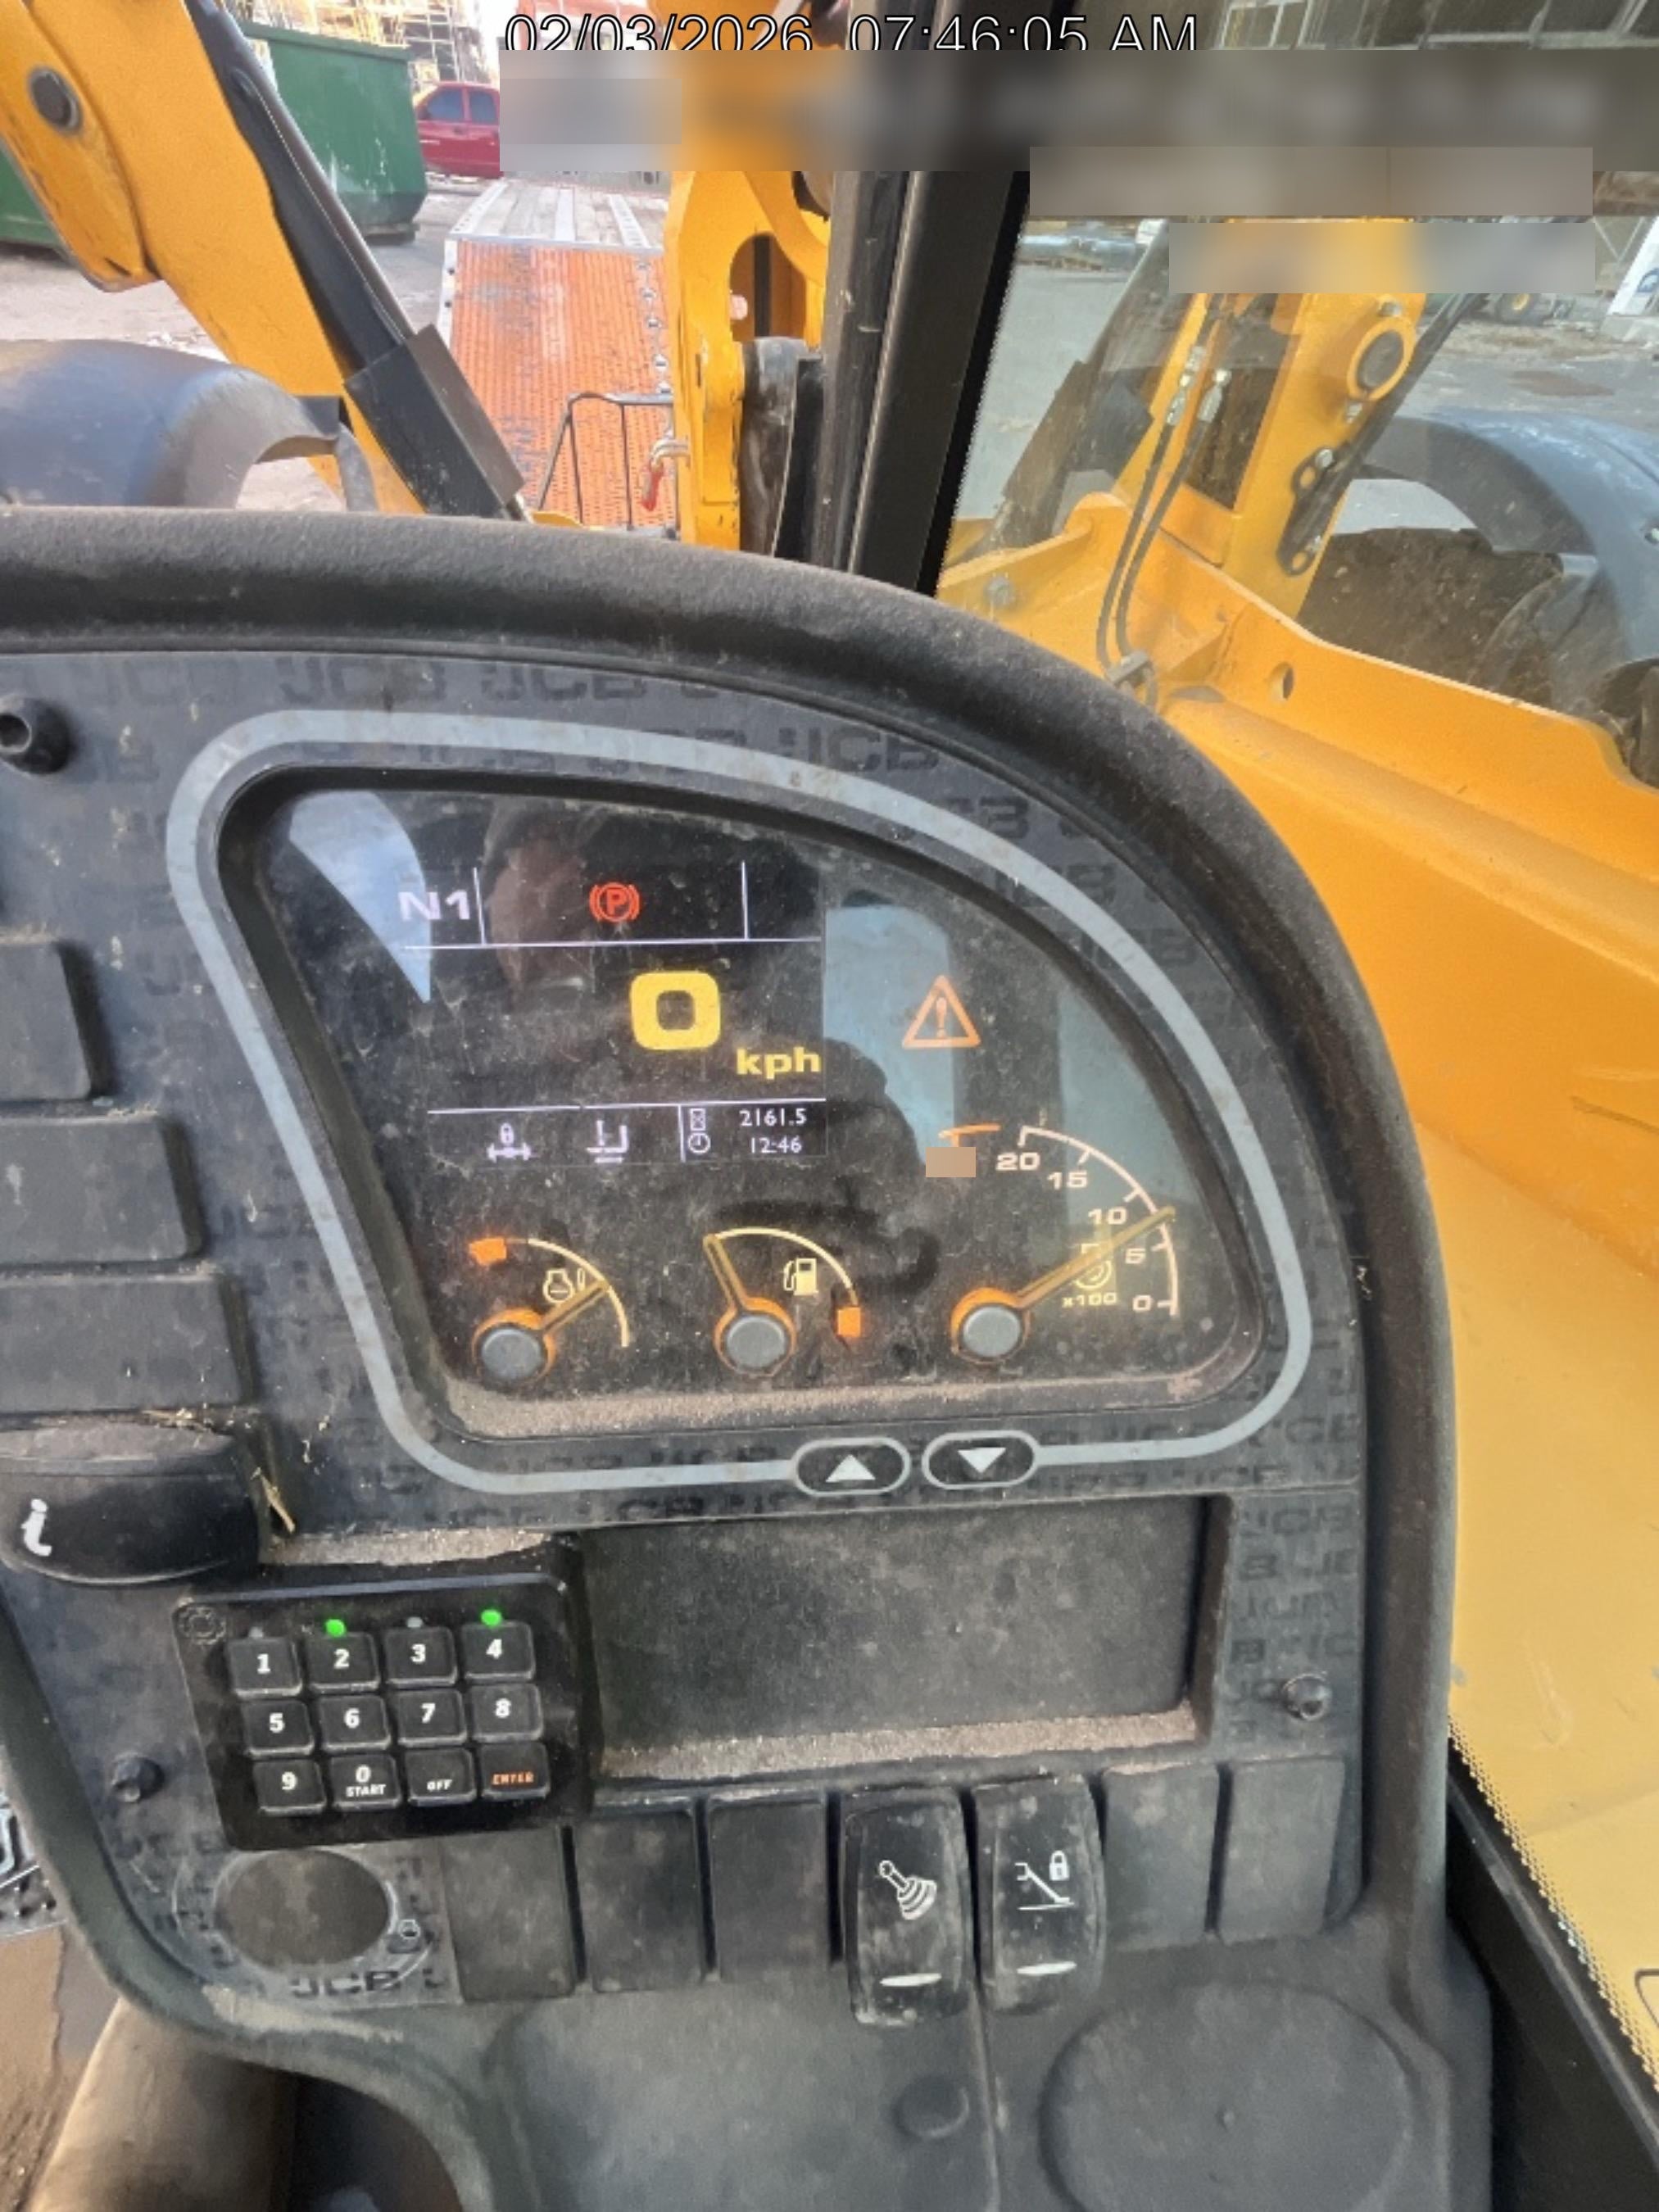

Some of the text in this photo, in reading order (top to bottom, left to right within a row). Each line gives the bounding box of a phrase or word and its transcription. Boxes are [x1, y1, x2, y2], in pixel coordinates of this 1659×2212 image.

[399, 889, 471, 921] N1
[630, 970, 721, 1050] 0
[737, 1046, 820, 1080] kph
[739, 1108, 807, 1126] 2161.5
[750, 1135, 803, 1154] 12:46
[995, 1152, 1040, 1172] 20
[1047, 1172, 1089, 1190] 15
[1088, 1207, 1127, 1226] 10
[1125, 1248, 1146, 1265] 5
[1132, 1294, 1153, 1312] 0
[333, 1648, 350, 1670] 2
[411, 1643, 427, 1664] 3
[487, 1639, 503, 1659] 4
[256, 1653, 271, 1675] 1
[344, 1708, 360, 1729] 6
[421, 1703, 436, 1724] 7
[496, 1698, 511, 1719] 8
[269, 1712, 284, 1733] 5
[281, 1771, 297, 1792] 9
[355, 1765, 372, 1784] 0
[492, 1771, 534, 1786] ENTER
[346, 1783, 386, 1797] START
[427, 1779, 452, 1792] OFF
